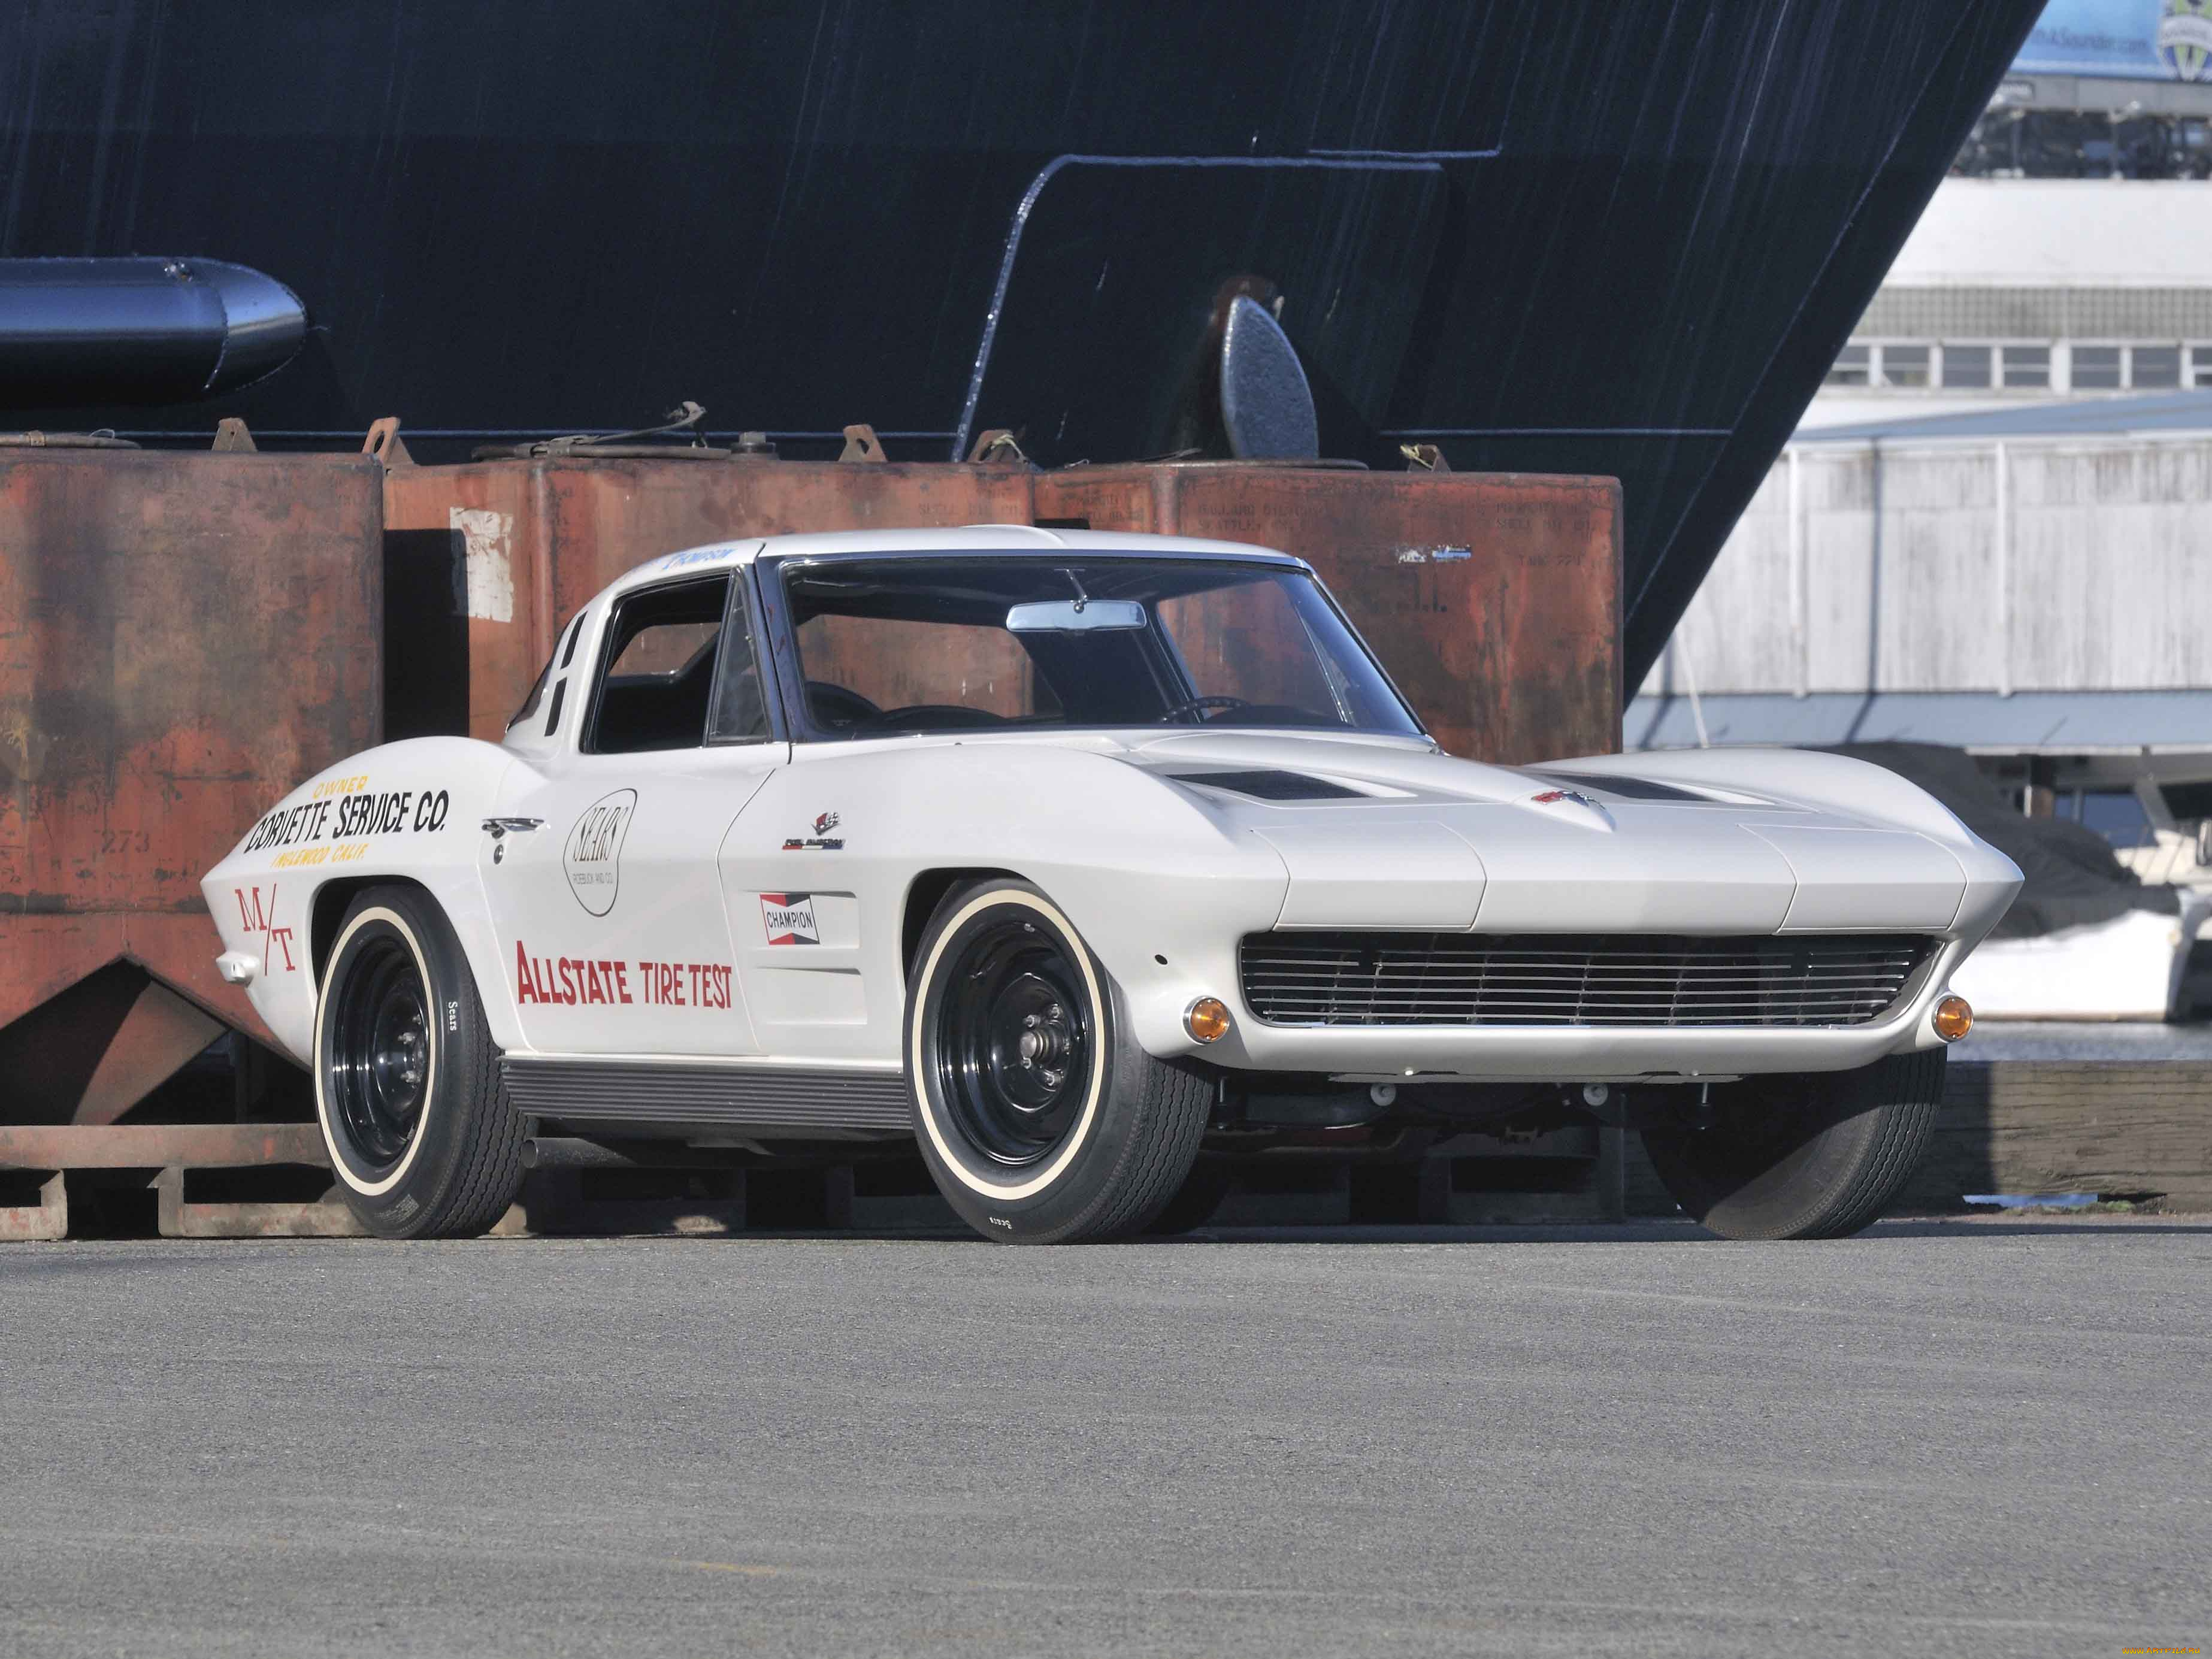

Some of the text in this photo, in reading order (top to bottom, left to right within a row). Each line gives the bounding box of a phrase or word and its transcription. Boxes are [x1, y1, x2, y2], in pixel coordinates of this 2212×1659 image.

[313, 776, 369, 799] OWNER
[243, 789, 449, 854] CORVETTE SERVICE CO.
[270, 845, 331, 868] INGLEWOOD
[766, 911, 814, 928] CHAMPION
[517, 940, 733, 1009] ALLSTATE TIRE TEST
[448, 1001, 458, 1031] Sears
